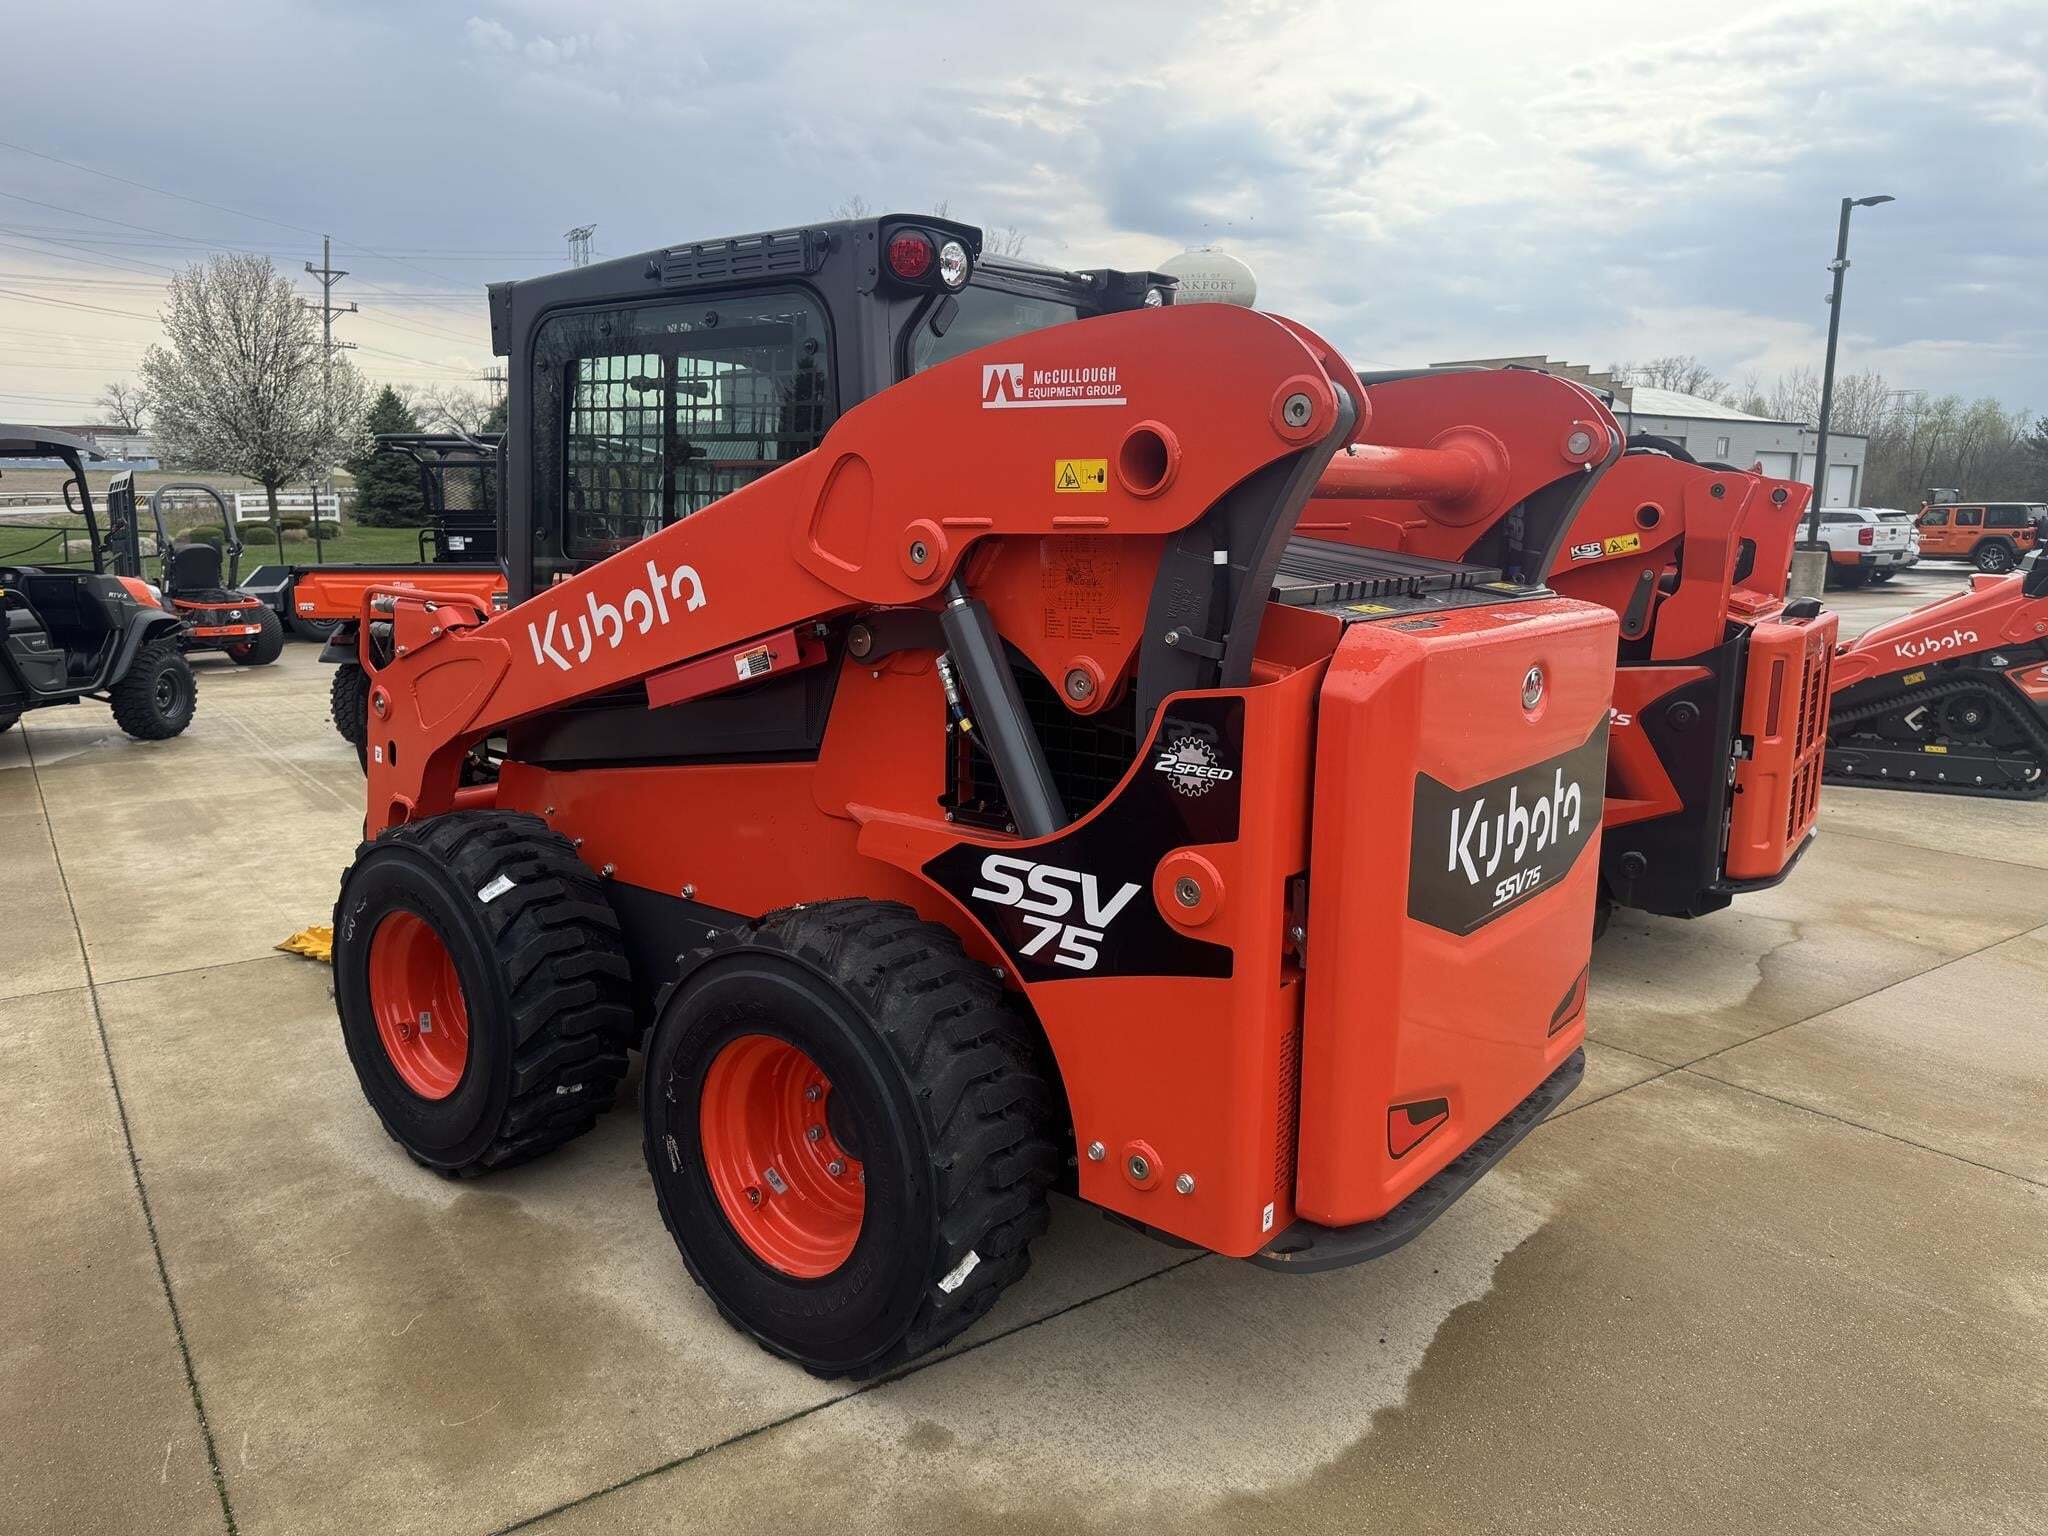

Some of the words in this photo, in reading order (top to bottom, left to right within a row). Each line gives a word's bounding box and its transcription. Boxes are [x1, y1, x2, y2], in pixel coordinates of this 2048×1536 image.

[1028, 385, 1084, 399] EQUIPMENT
[1086, 384, 1122, 396] GROUP
[1033, 366, 1117, 385] McCULLOUGH
[527, 559, 707, 672] Kubota
[1894, 629, 1979, 658] Kubota
[1448, 767, 1581, 885] Kubota
[971, 854, 1142, 929] SSV
[1018, 914, 1104, 971] 75
